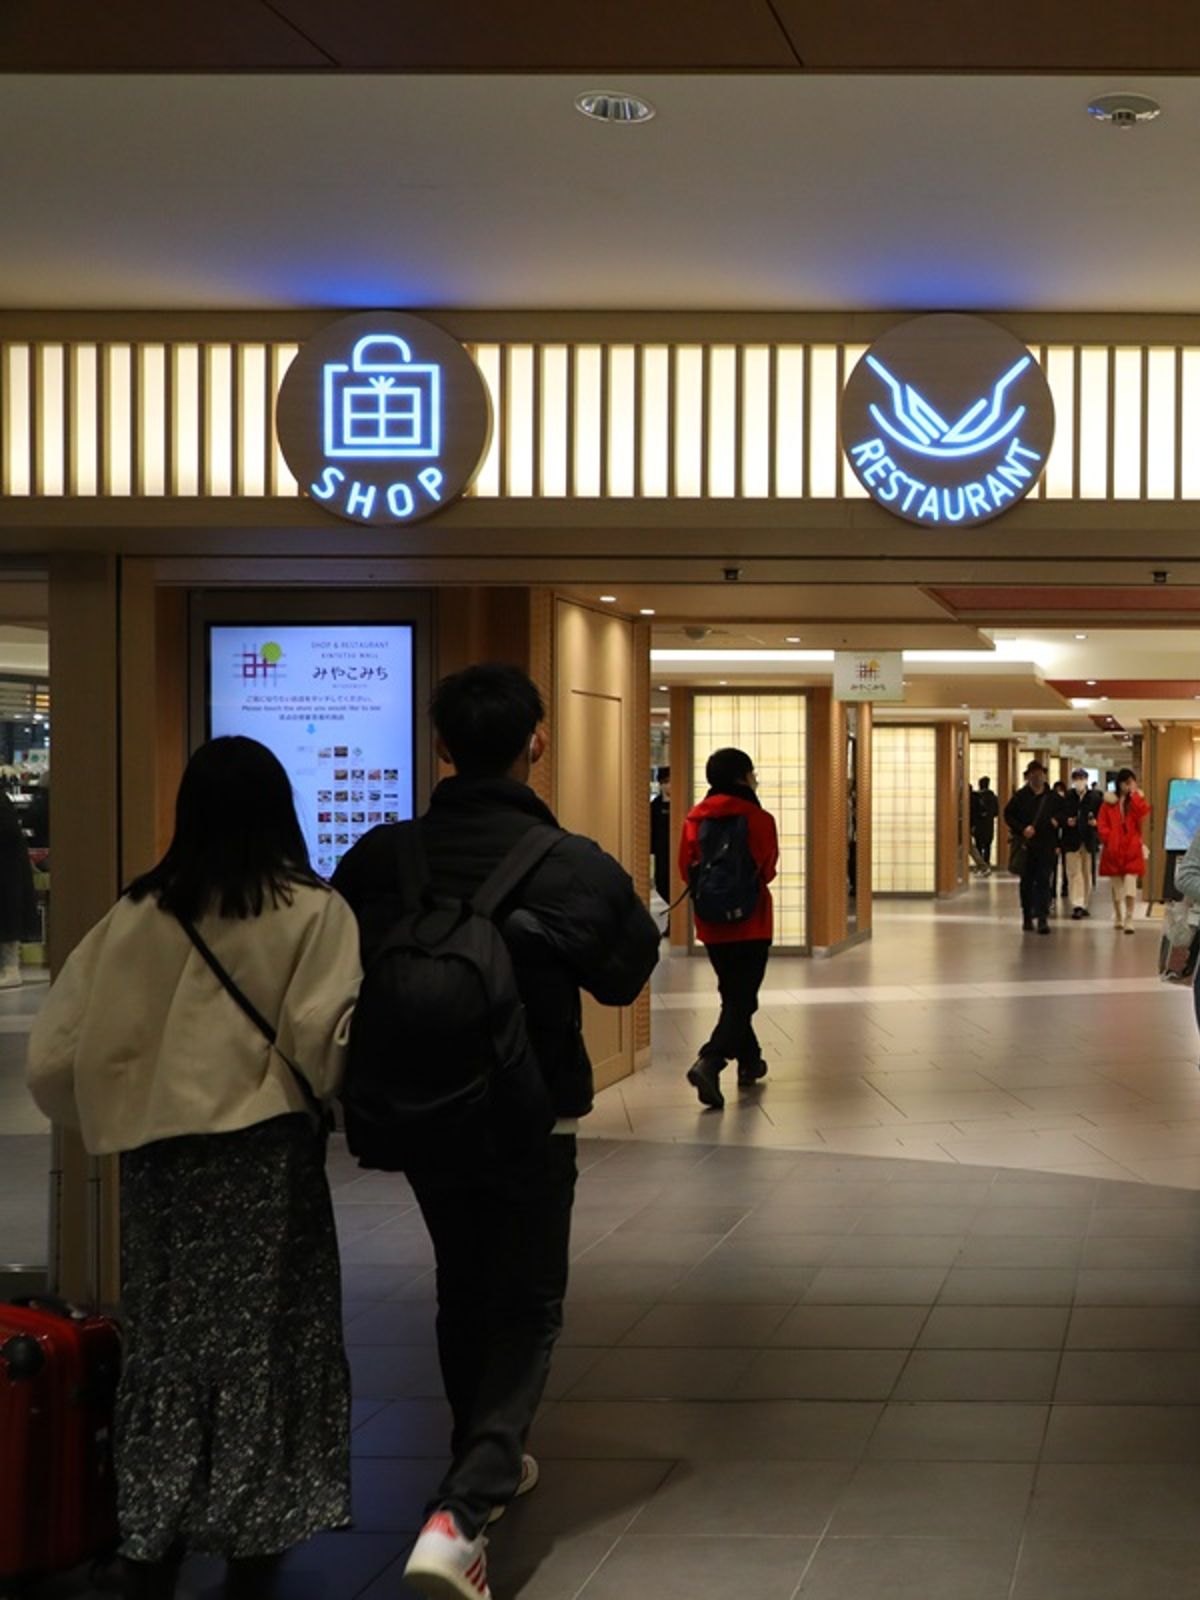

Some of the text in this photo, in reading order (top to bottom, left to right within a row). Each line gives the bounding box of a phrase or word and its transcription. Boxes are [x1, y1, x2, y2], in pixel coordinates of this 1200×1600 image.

[311, 466, 443, 518] SHOP
[851, 437, 1041, 521] RESTAURANT
[312, 666, 389, 681] みやこみち
